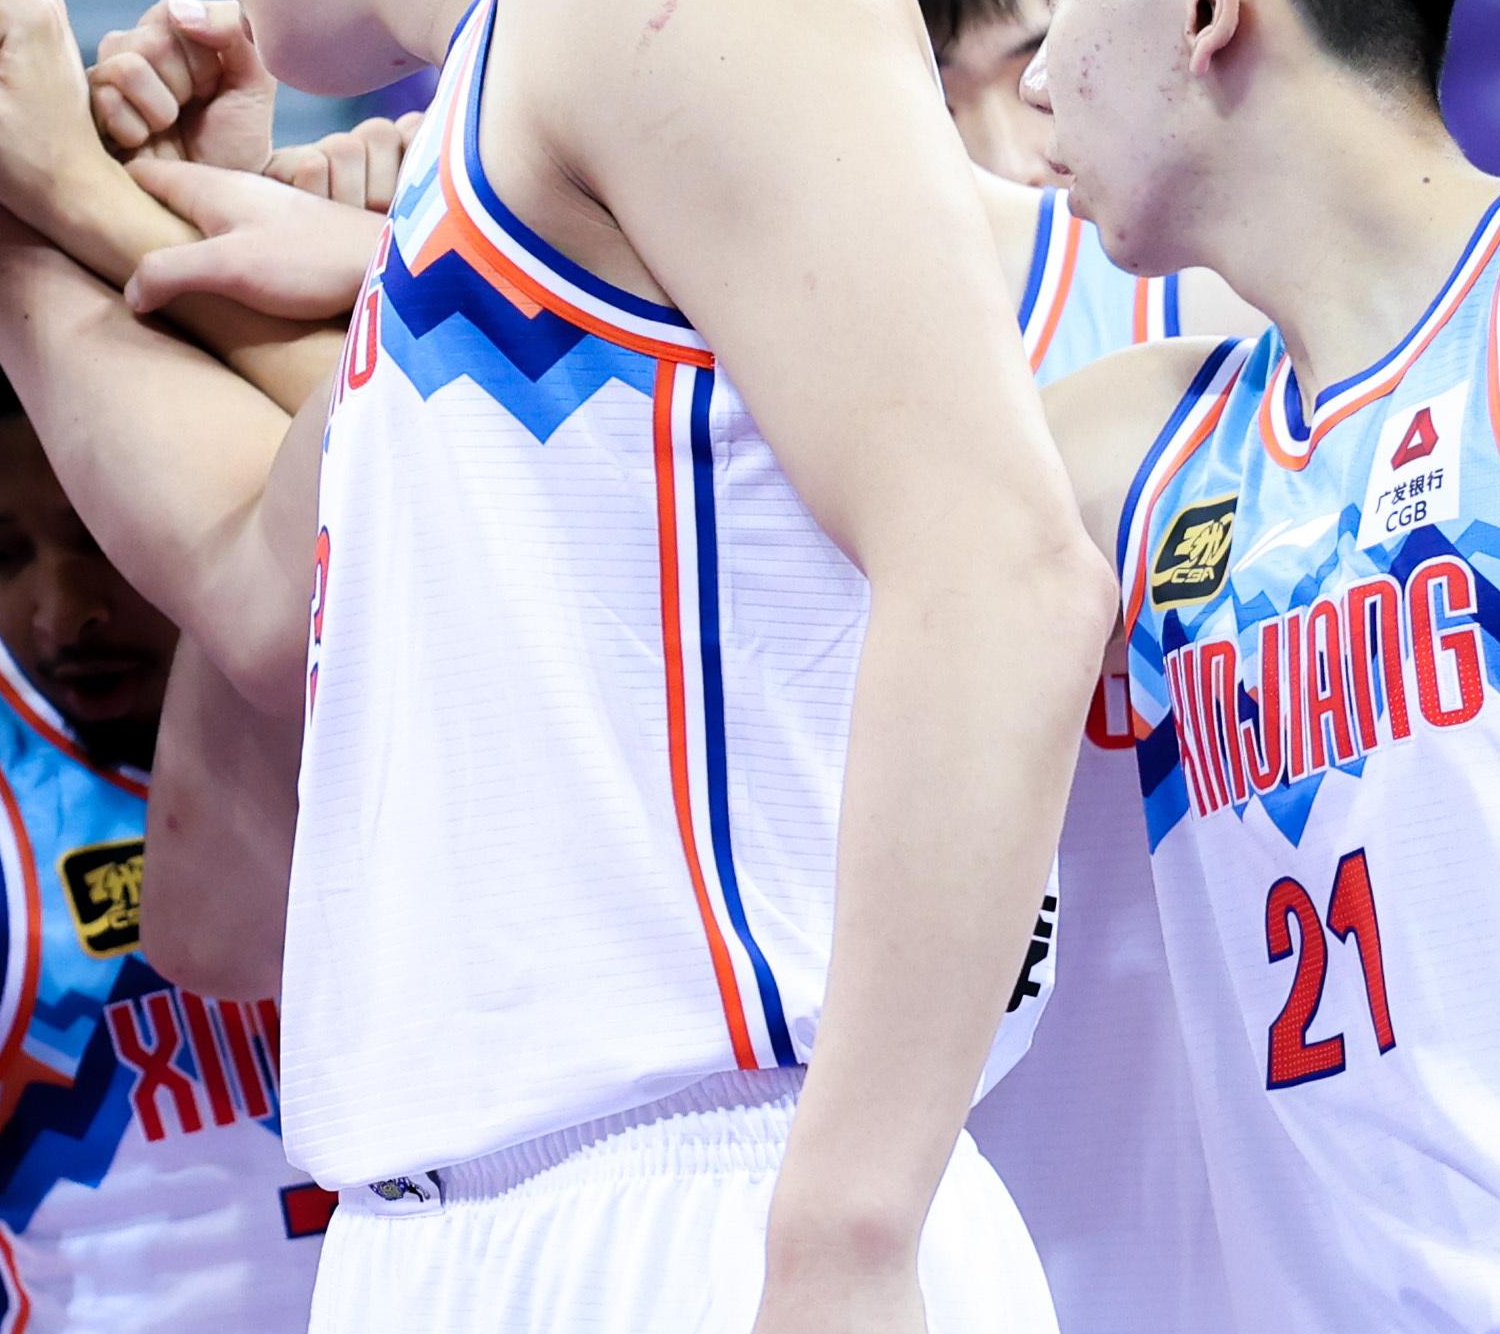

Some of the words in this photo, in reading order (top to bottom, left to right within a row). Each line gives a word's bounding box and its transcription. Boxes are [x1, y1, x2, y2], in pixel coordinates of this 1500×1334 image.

[1376, 468, 1444, 514] 广发银行
[1386, 500, 1427, 532] CGB
[1163, 554, 1486, 819] XINJIANG
[1266, 846, 1396, 1091] 21
